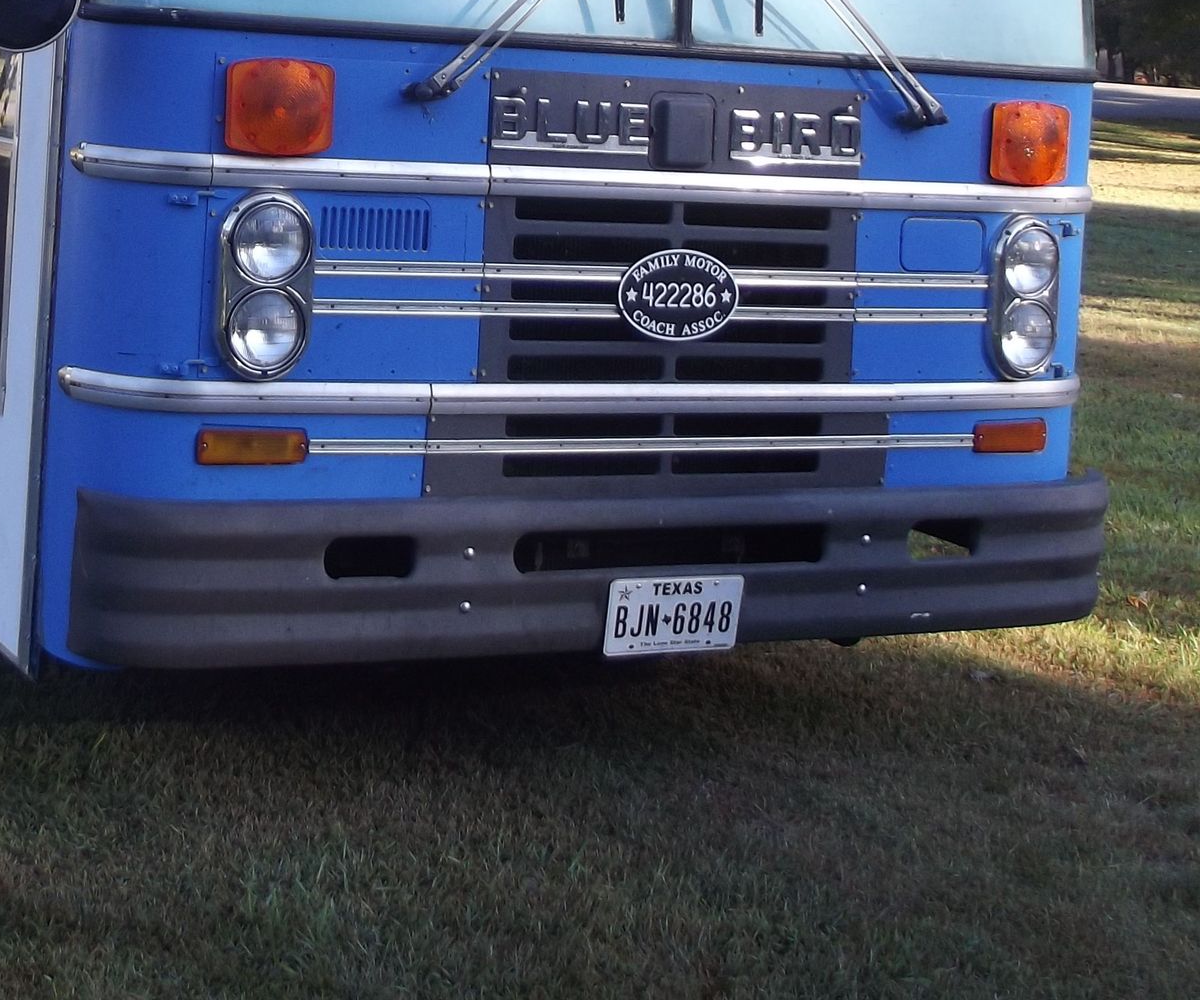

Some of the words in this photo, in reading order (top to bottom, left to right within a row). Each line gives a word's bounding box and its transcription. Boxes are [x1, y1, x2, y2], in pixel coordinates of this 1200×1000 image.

[492, 96, 649, 146] BLUE
[730, 109, 861, 156] BIRD
[632, 254, 680, 283] FAMILY
[684, 254, 727, 284] MOTOR
[642, 282, 717, 308] 422286
[633, 310, 676, 336] COACH
[681, 310, 727, 336] ASSOC.
[653, 581, 703, 596] TEXAS
